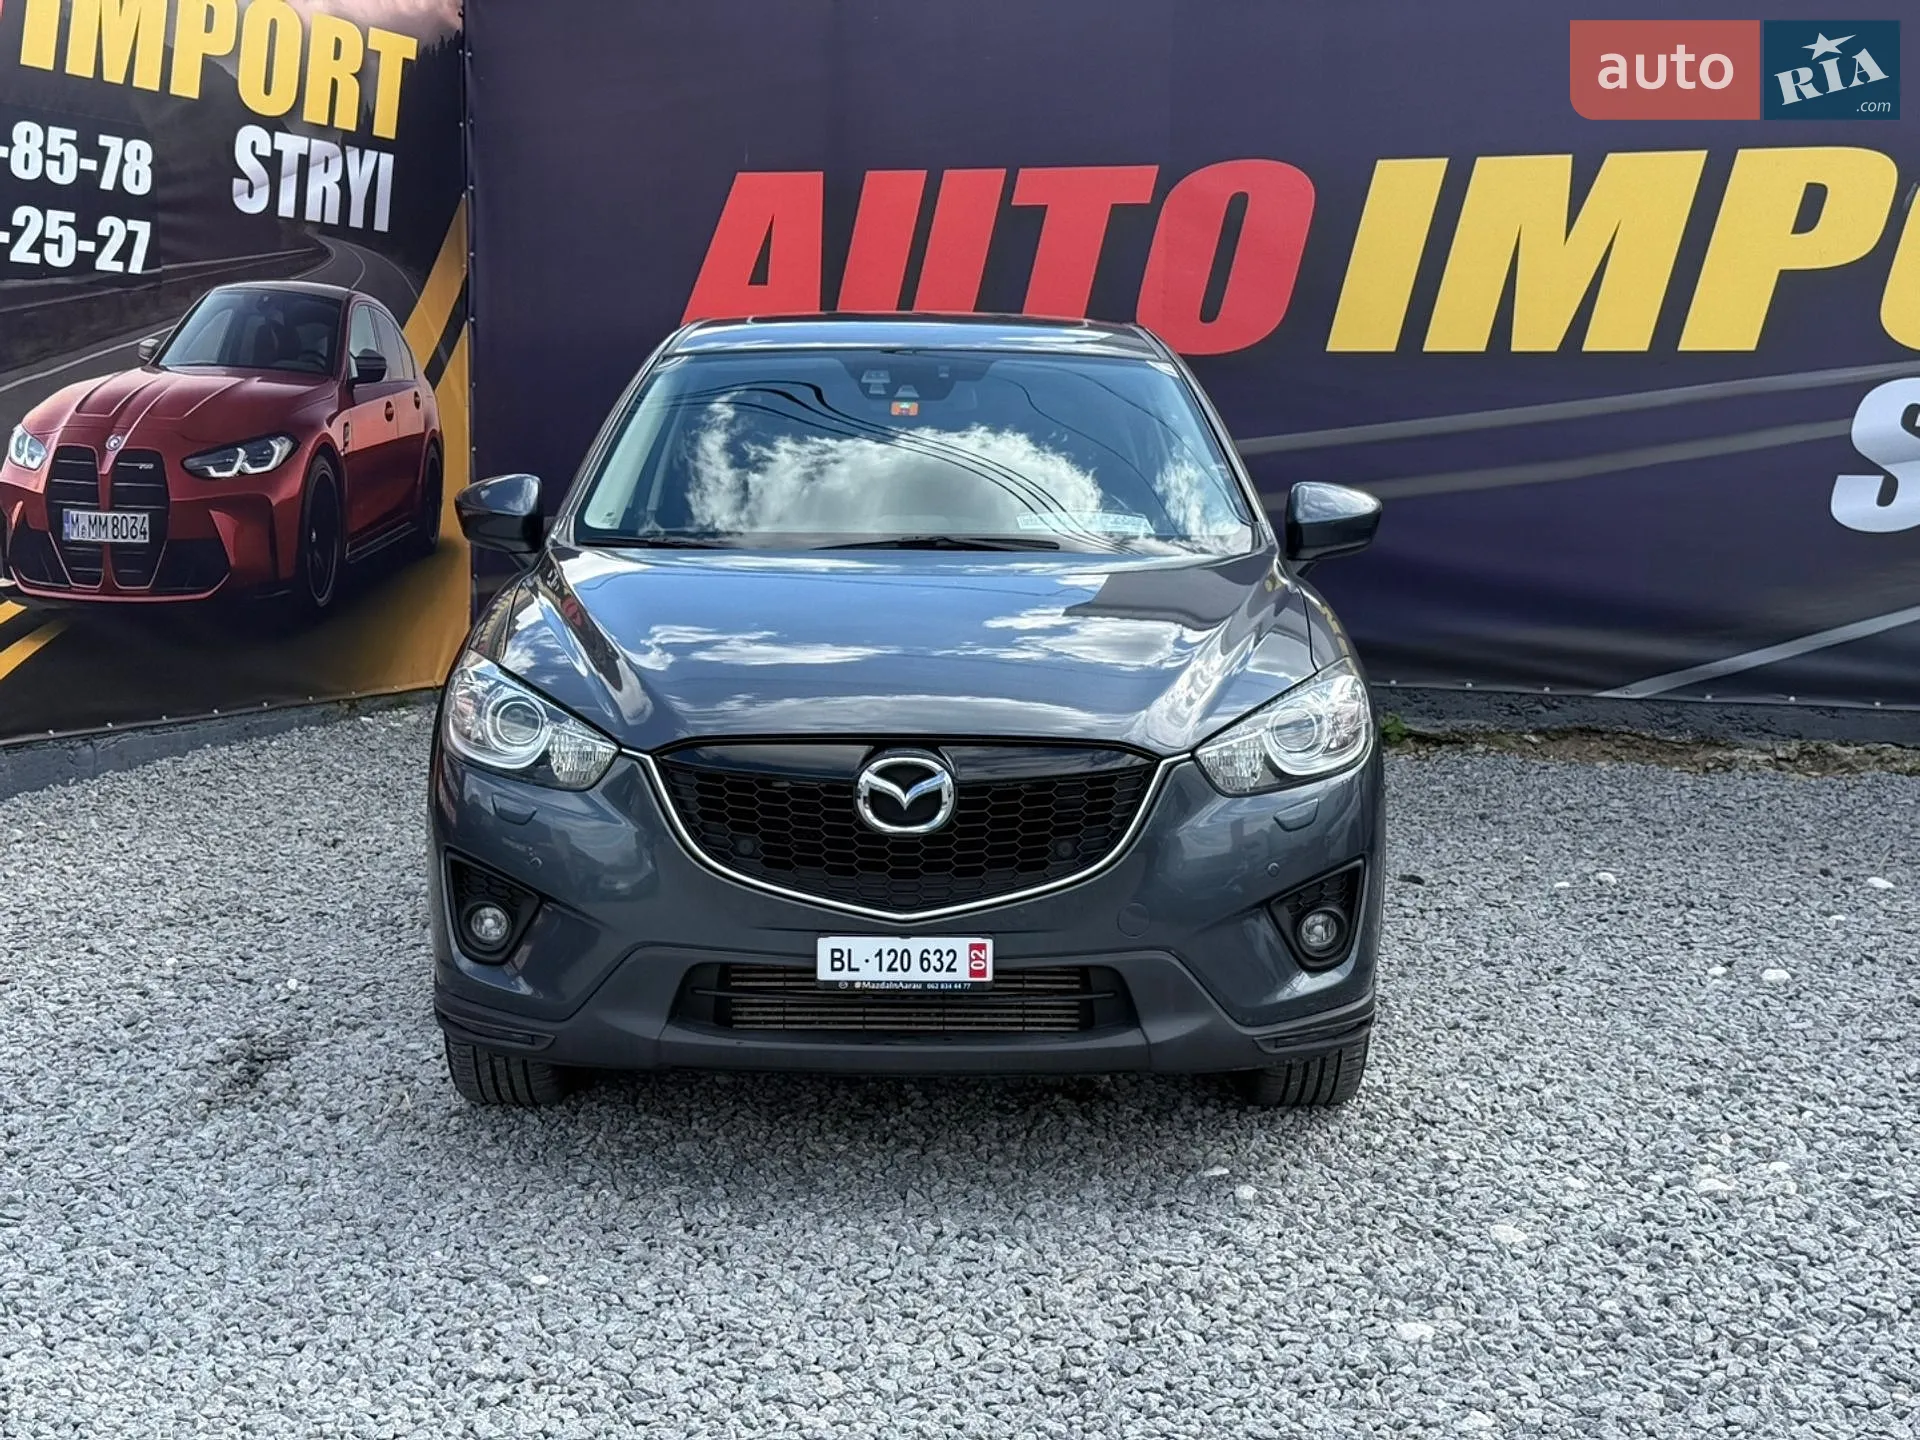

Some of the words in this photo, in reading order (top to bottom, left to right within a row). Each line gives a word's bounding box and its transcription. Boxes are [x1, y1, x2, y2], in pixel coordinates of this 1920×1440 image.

[20, 0, 418, 140] IMPORT
[231, 124, 395, 233] STRYI
[684, 158, 1315, 356] AUTO
[1326, 146, 1920, 352] IMP
[918, 948, 958, 973] 632
[970, 951, 986, 970] 02
